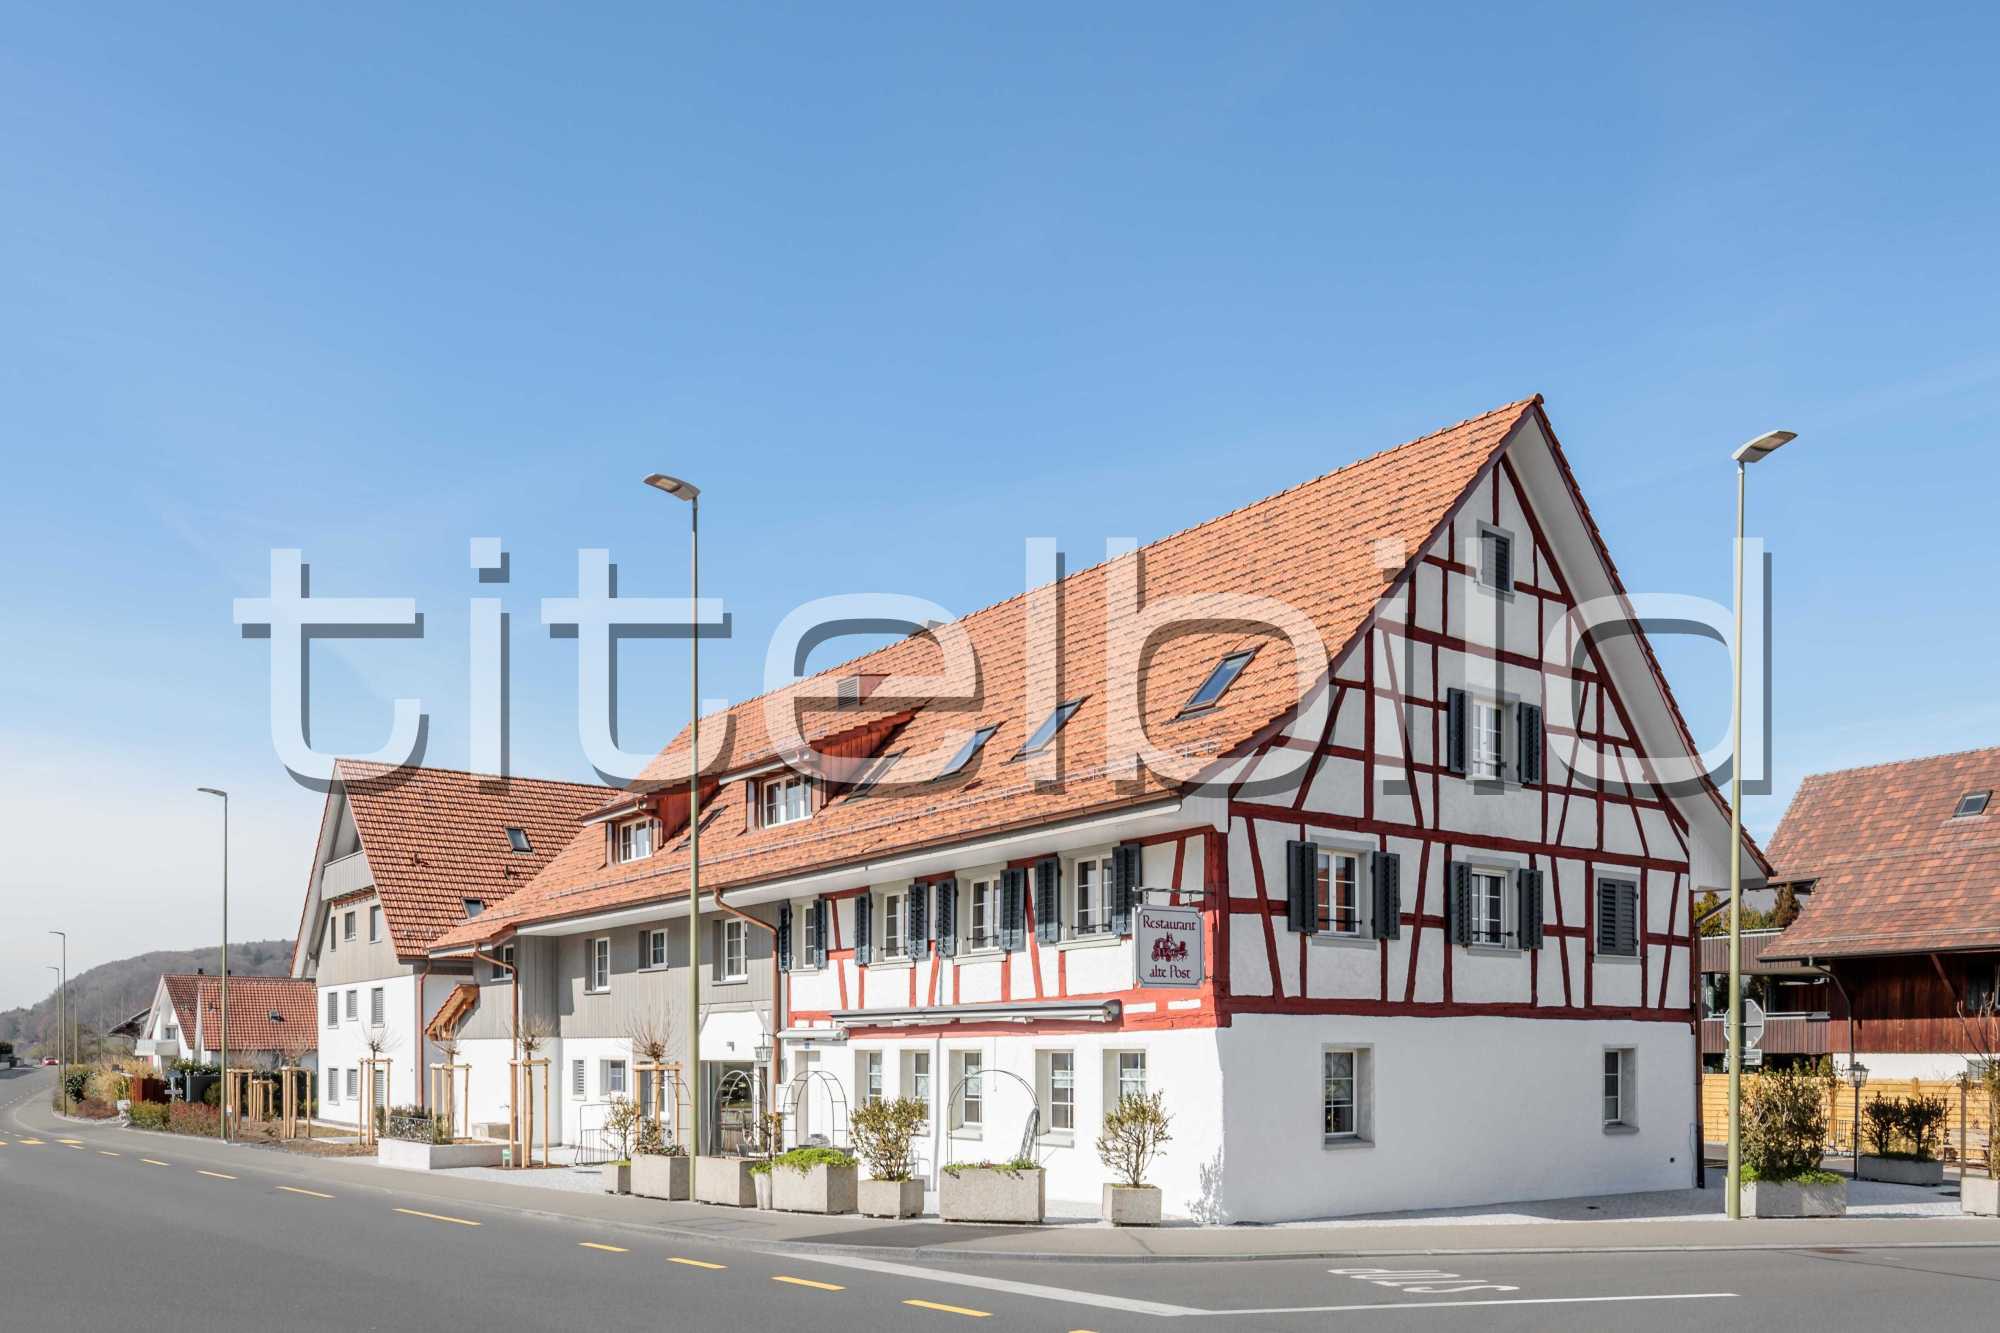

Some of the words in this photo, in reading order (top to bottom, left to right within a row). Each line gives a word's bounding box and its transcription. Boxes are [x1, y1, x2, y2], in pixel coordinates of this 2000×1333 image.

[1142, 914, 1196, 931] Restaurant
[1149, 964, 1167, 978] alte
[1170, 965, 1192, 979] Post
[1327, 1268, 1521, 1294] STOP
